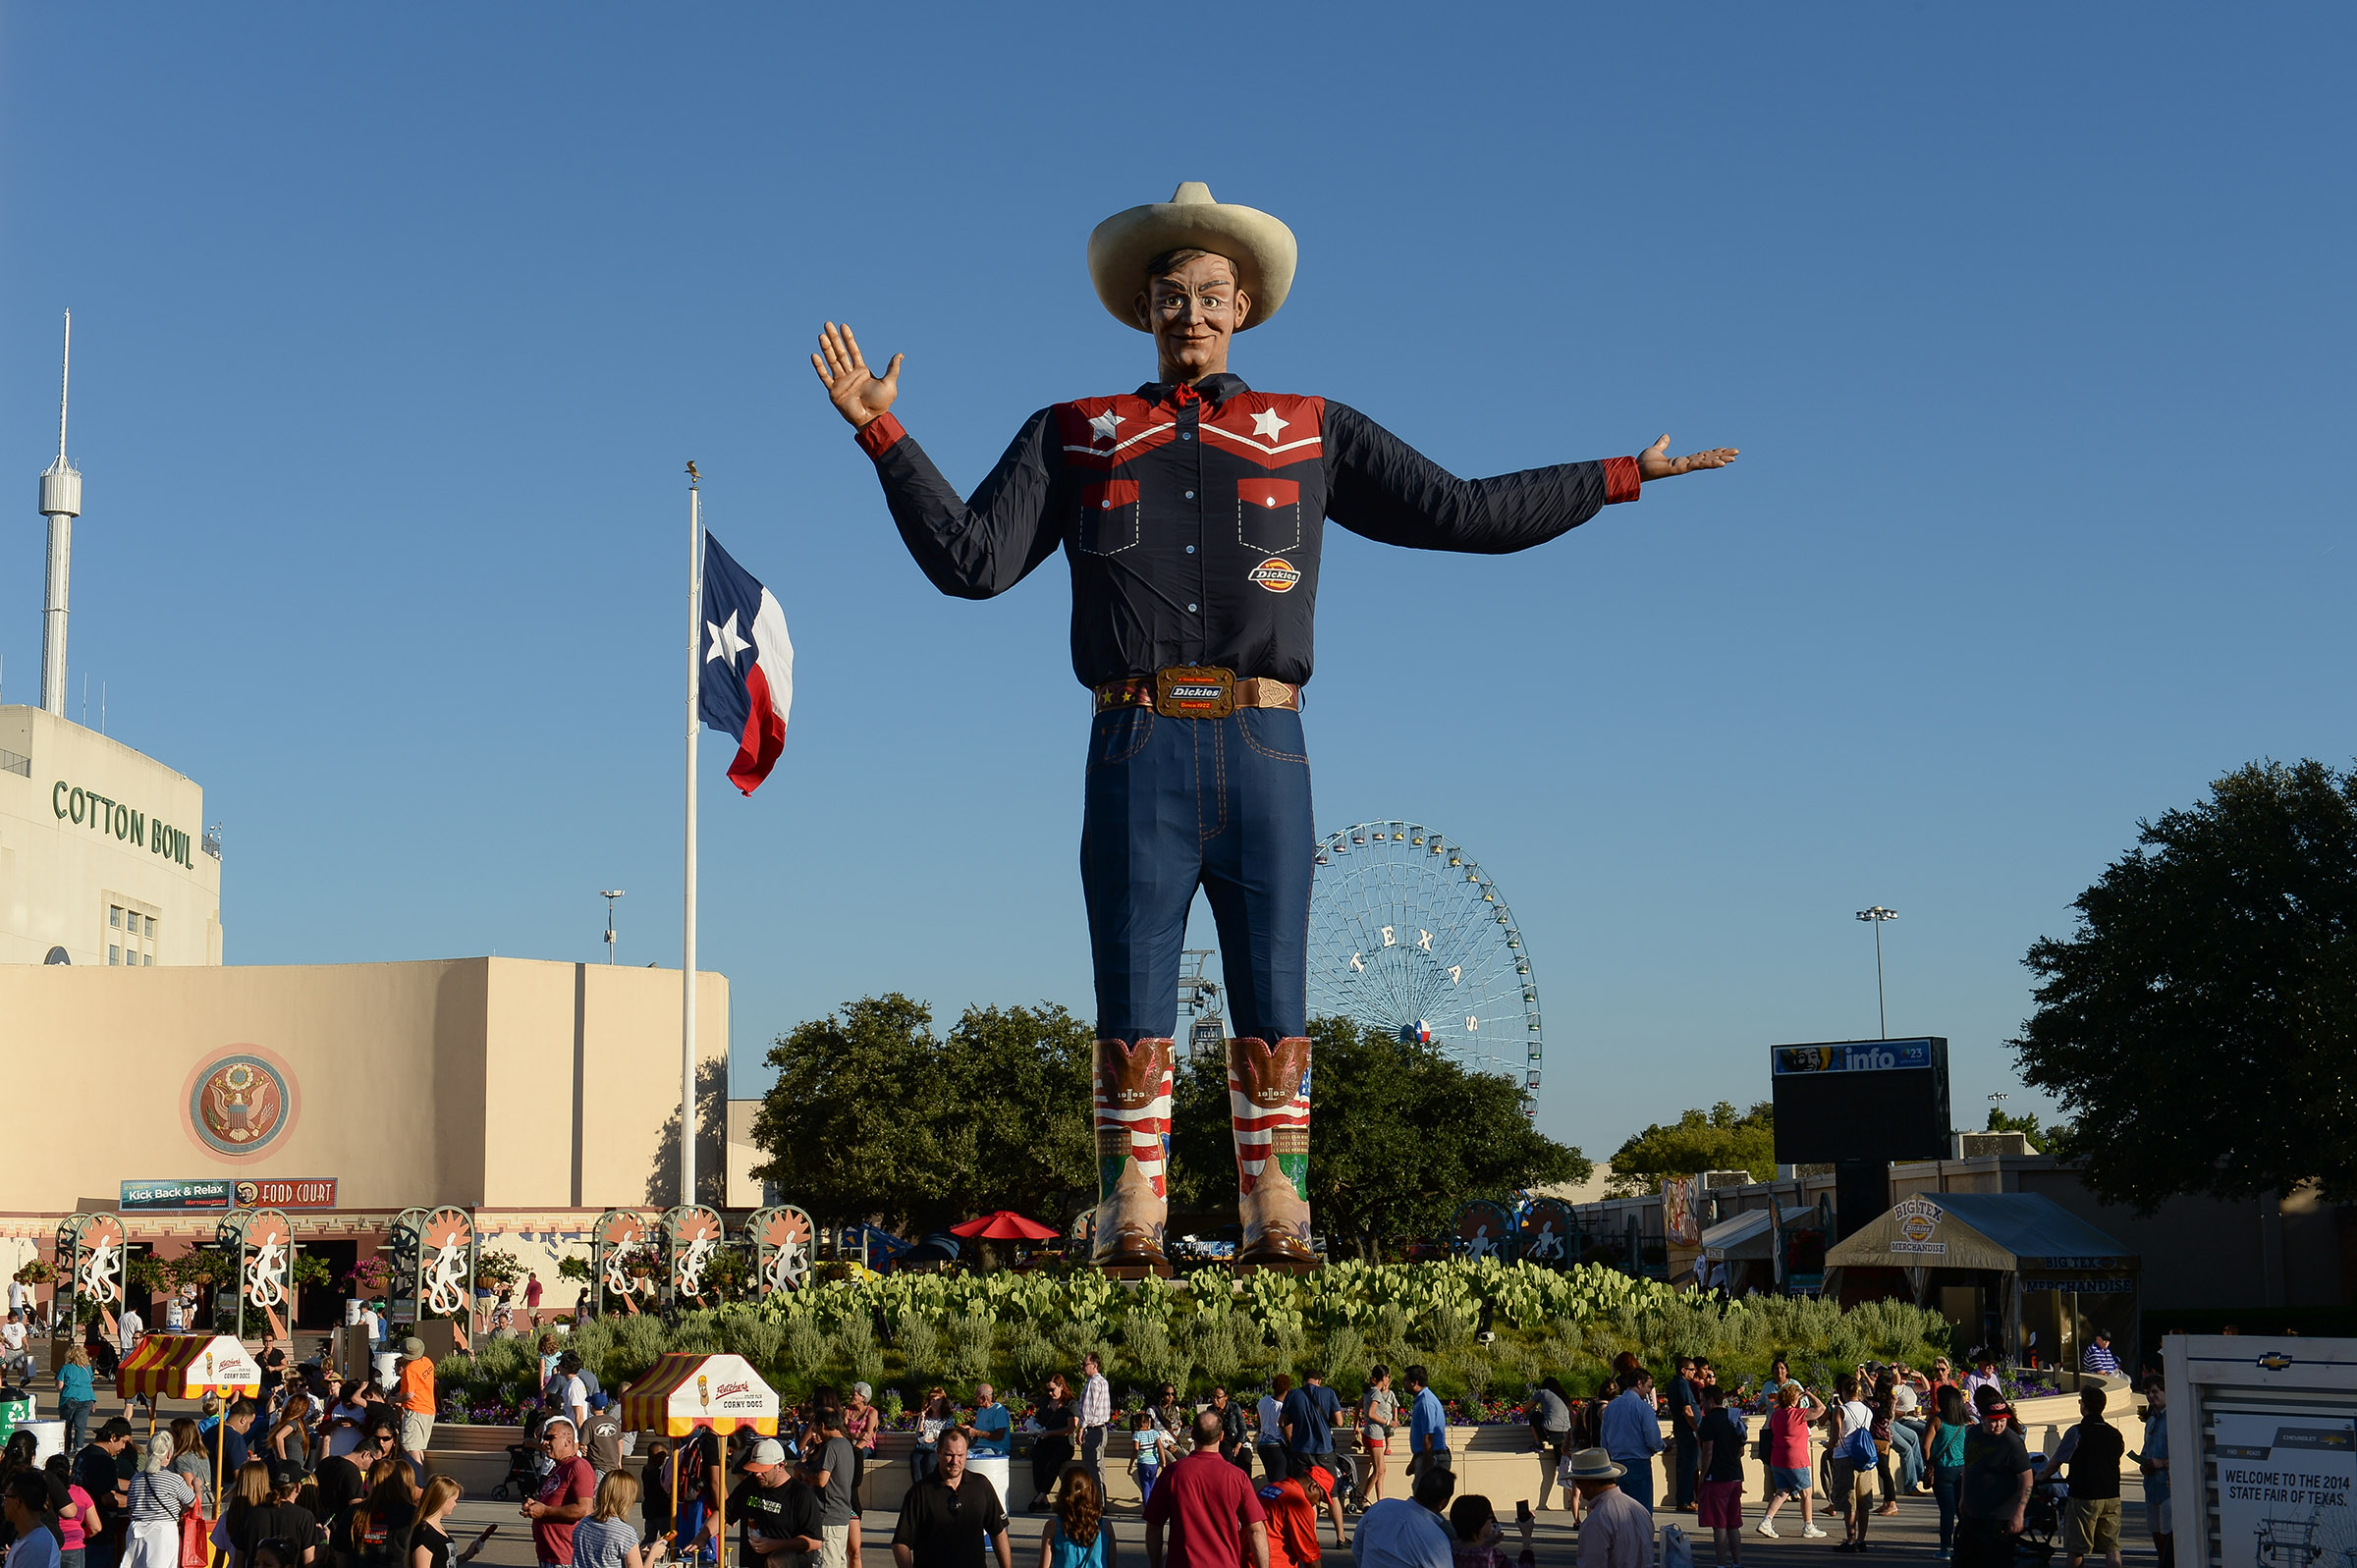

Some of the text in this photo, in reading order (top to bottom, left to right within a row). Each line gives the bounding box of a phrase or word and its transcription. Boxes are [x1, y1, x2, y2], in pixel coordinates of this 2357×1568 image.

[1256, 570, 1296, 580] Dickies
[1174, 688, 1220, 697] Dickies
[52, 780, 194, 870] COTTON BOWL
[1348, 925, 1479, 1033] TEXAS
[1845, 1046, 1895, 1070] info
[1910, 1048, 1923, 1058] 23
[129, 1184, 223, 1201] Kick Back & Relax
[262, 1183, 332, 1204] FOOD COURT
[1894, 1201, 1943, 1221] BIG TEX
[1891, 1242, 1945, 1253] MERCHANDISE
[2045, 1257, 2068, 1269] BIG
[2072, 1257, 2097, 1269] TEX
[2225, 1470, 2350, 1490] WELCOME TO THE 2014
[2229, 1486, 2347, 1507] STATE FAIR OF TEXAS.
